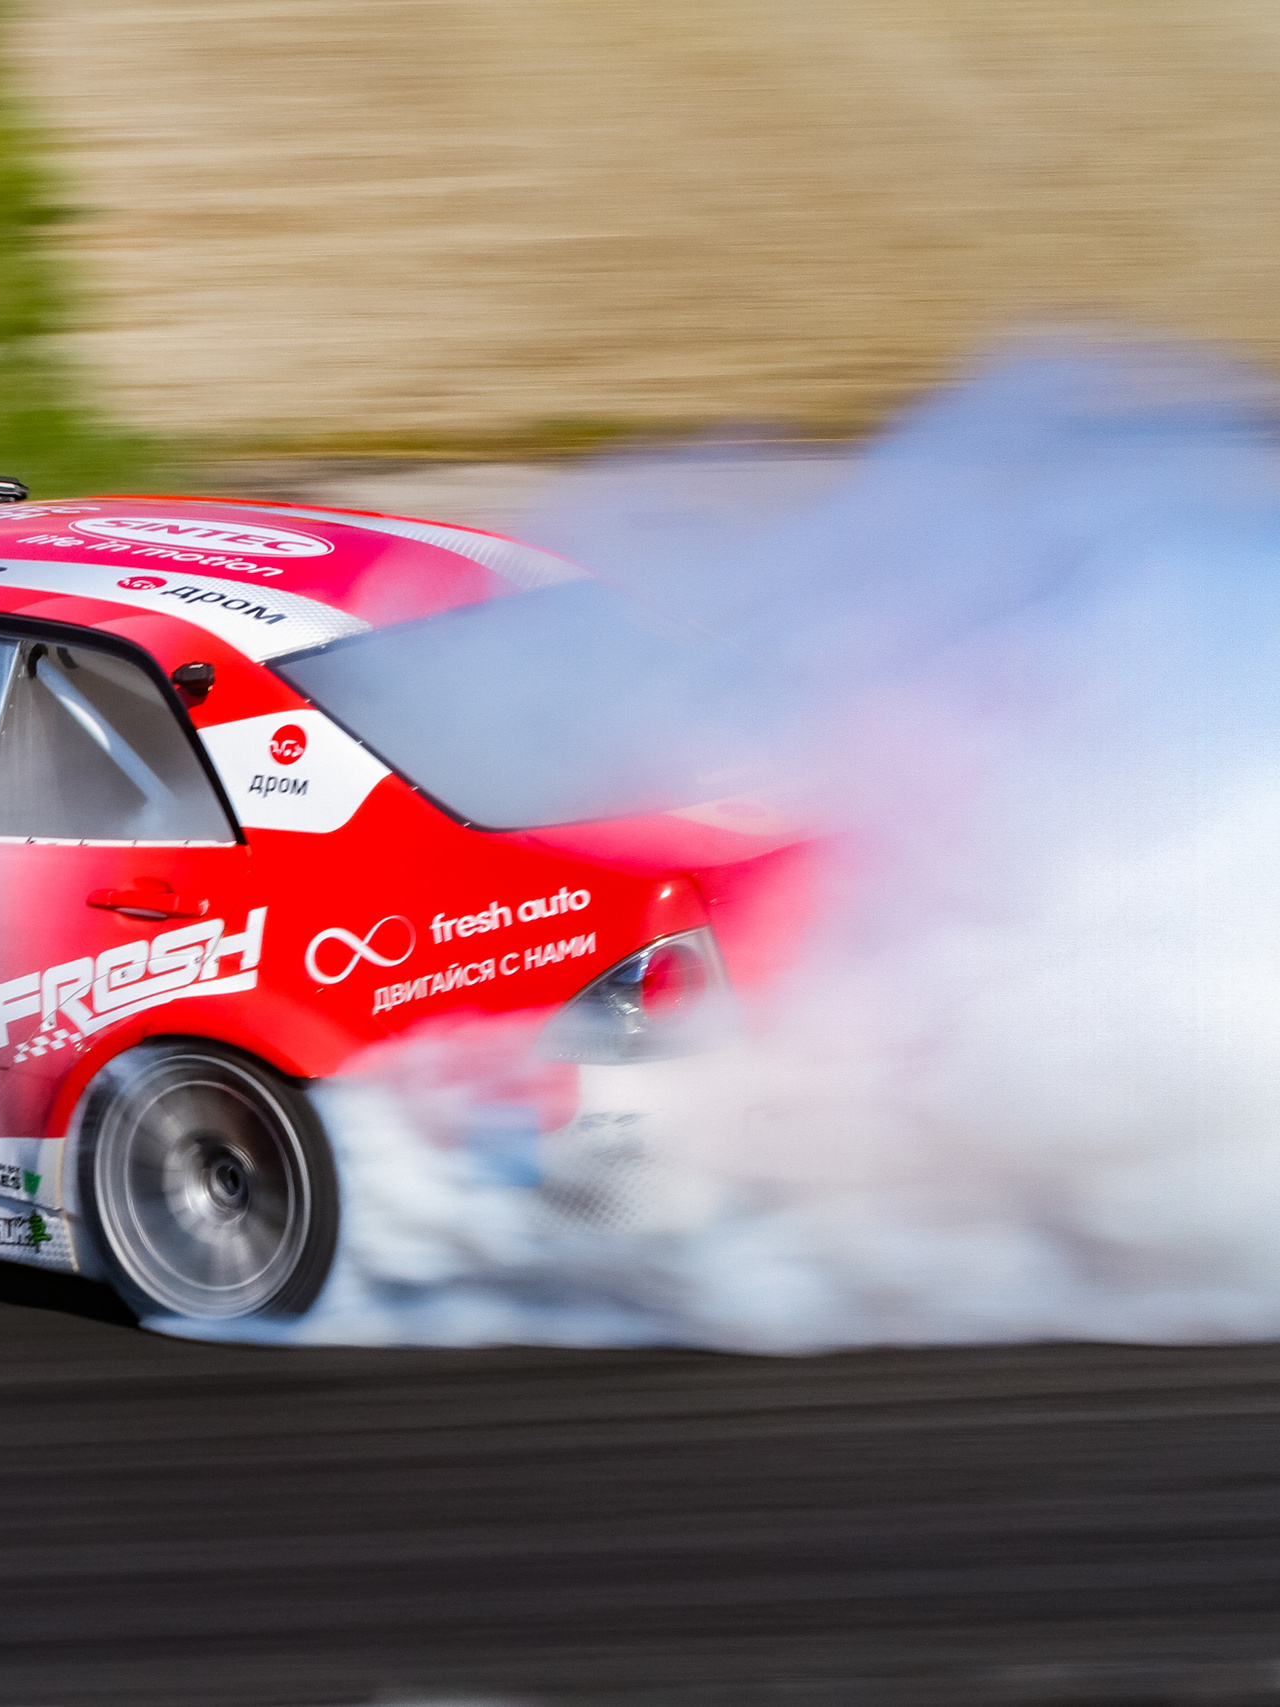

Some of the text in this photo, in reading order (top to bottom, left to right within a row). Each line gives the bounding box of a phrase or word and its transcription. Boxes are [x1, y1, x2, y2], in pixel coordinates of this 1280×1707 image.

[16, 534, 285, 577] life in motion
[91, 519, 314, 552] SINTEC
[159, 585, 288, 626] дром
[248, 774, 310, 798] дром
[429, 886, 592, 945] fresh auto
[372, 931, 597, 1016] ДВИГАЙСЯ С НАМИ
